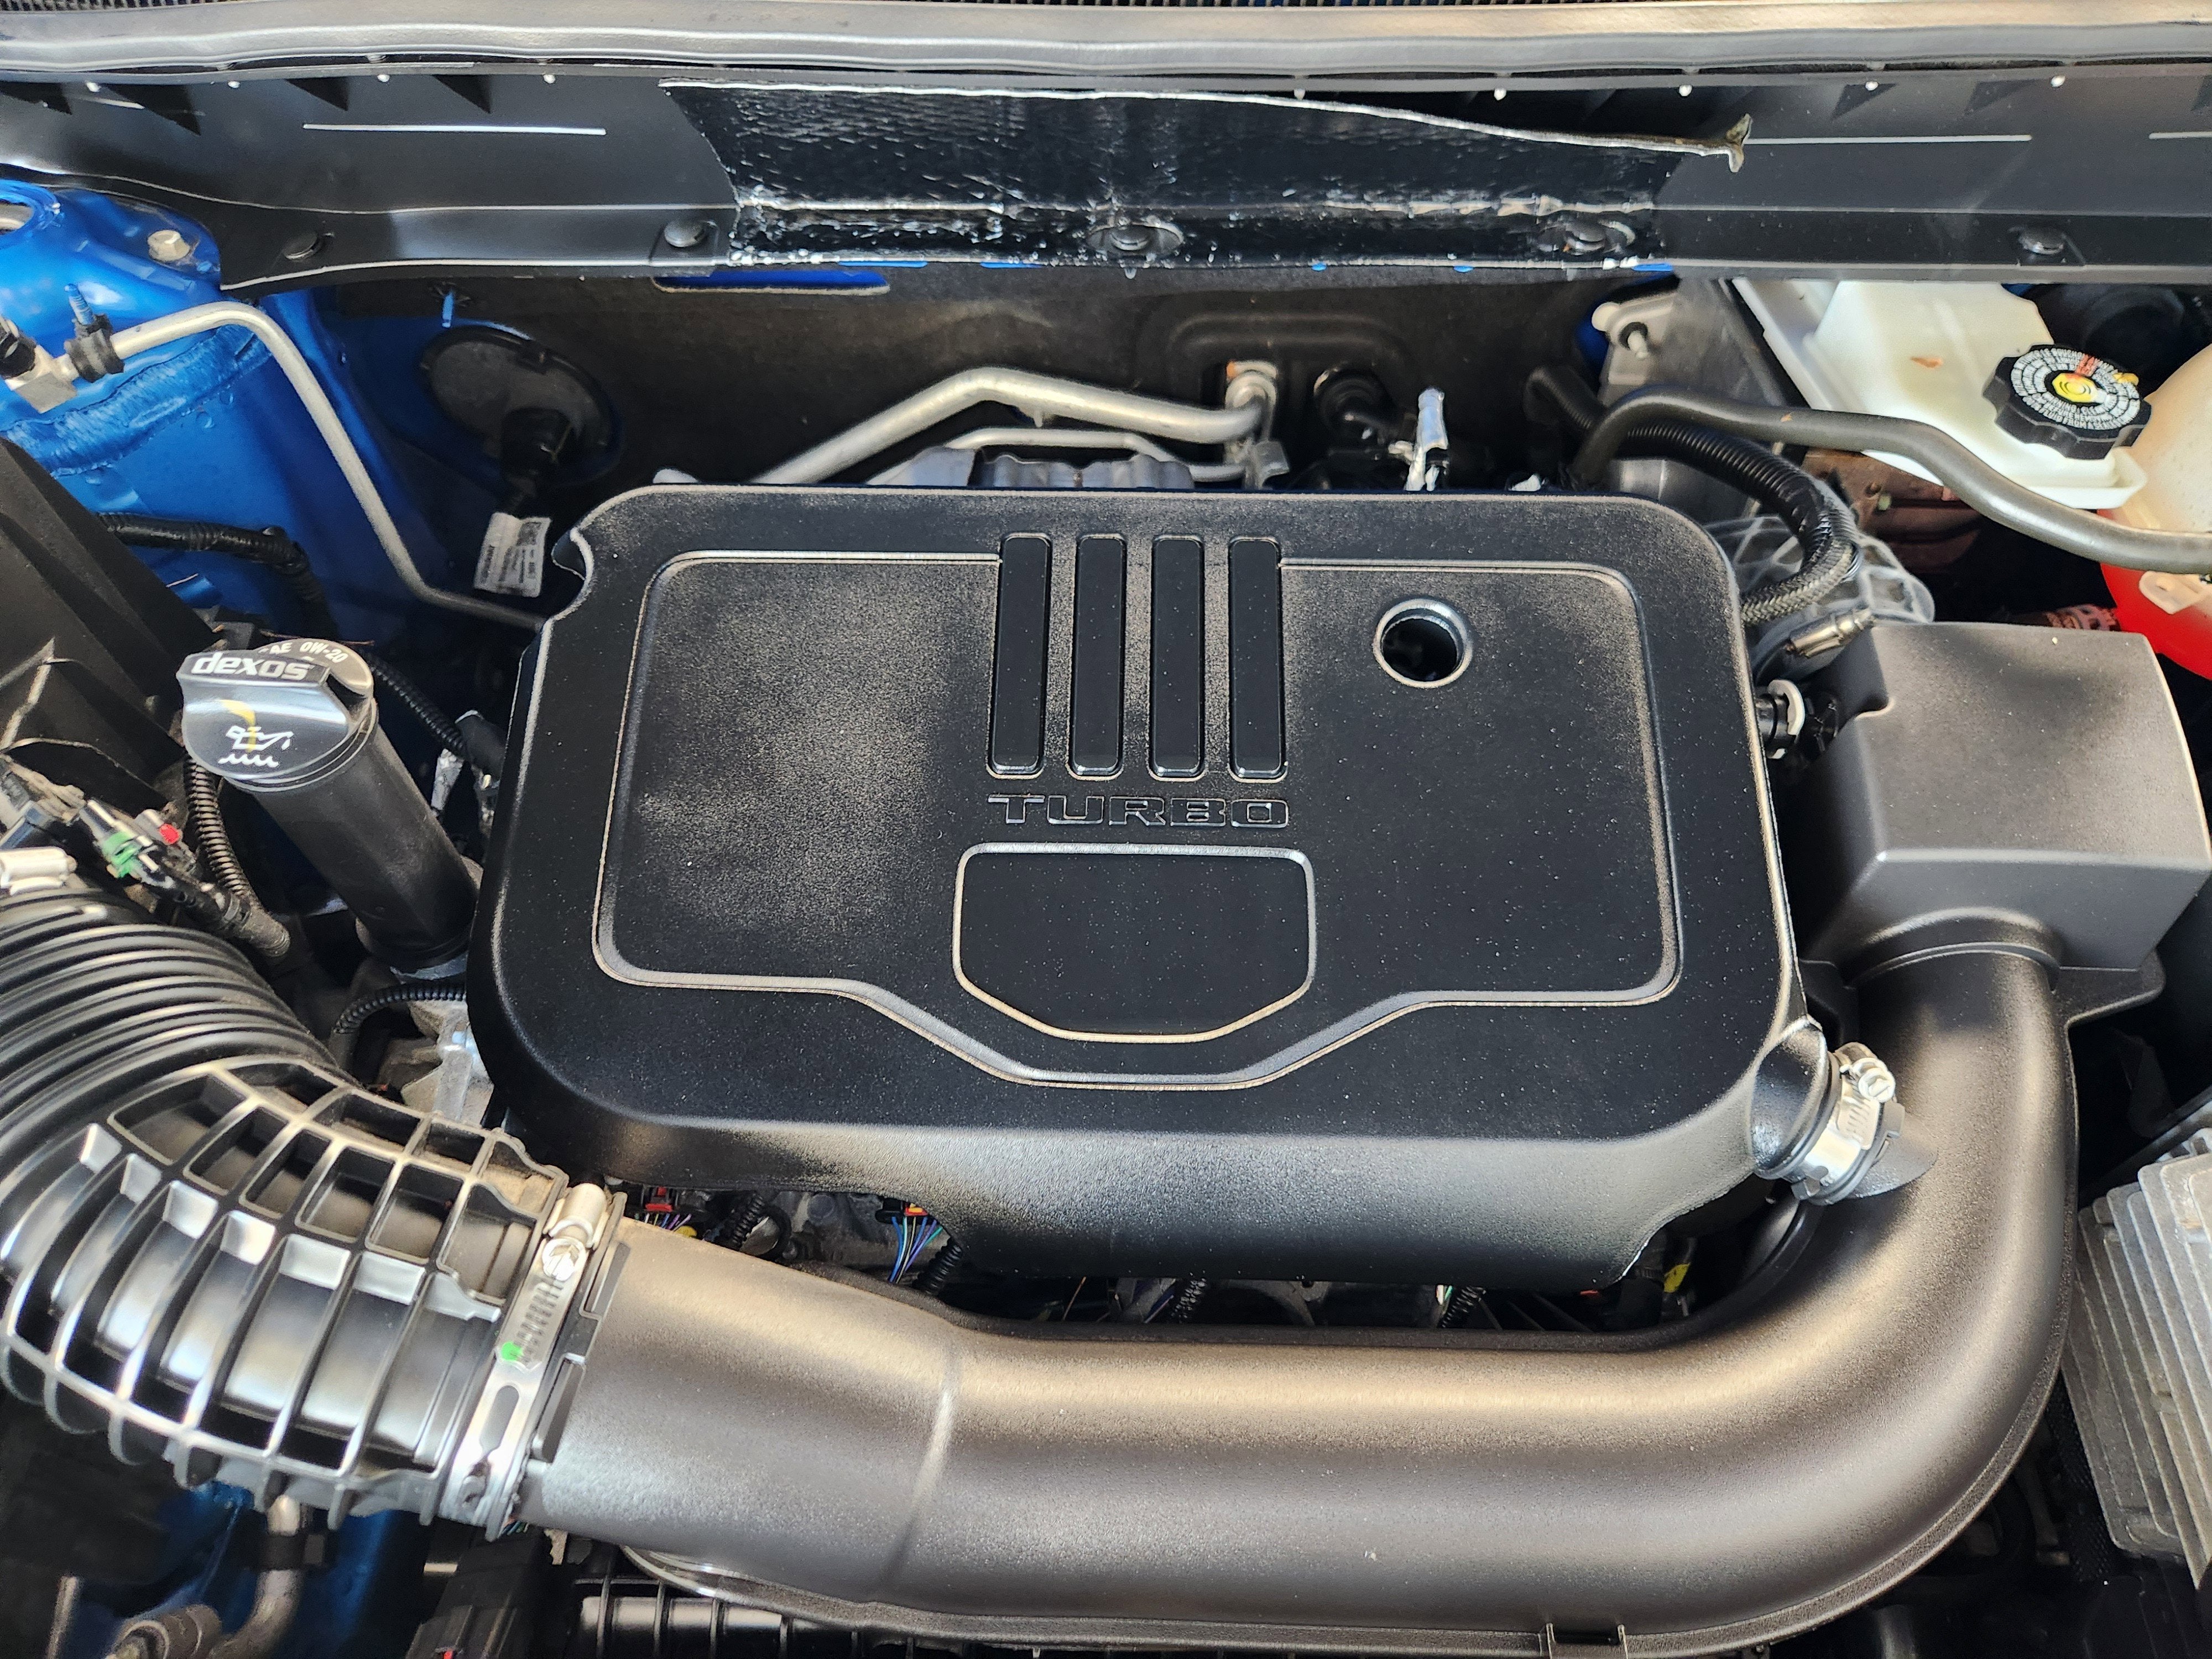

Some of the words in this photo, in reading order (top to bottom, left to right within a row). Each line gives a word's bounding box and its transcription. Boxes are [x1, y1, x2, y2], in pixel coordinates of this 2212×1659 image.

[191, 652, 315, 681] dexos
[299, 641, 348, 663] 0W-20
[988, 793, 1289, 828] TURBO
